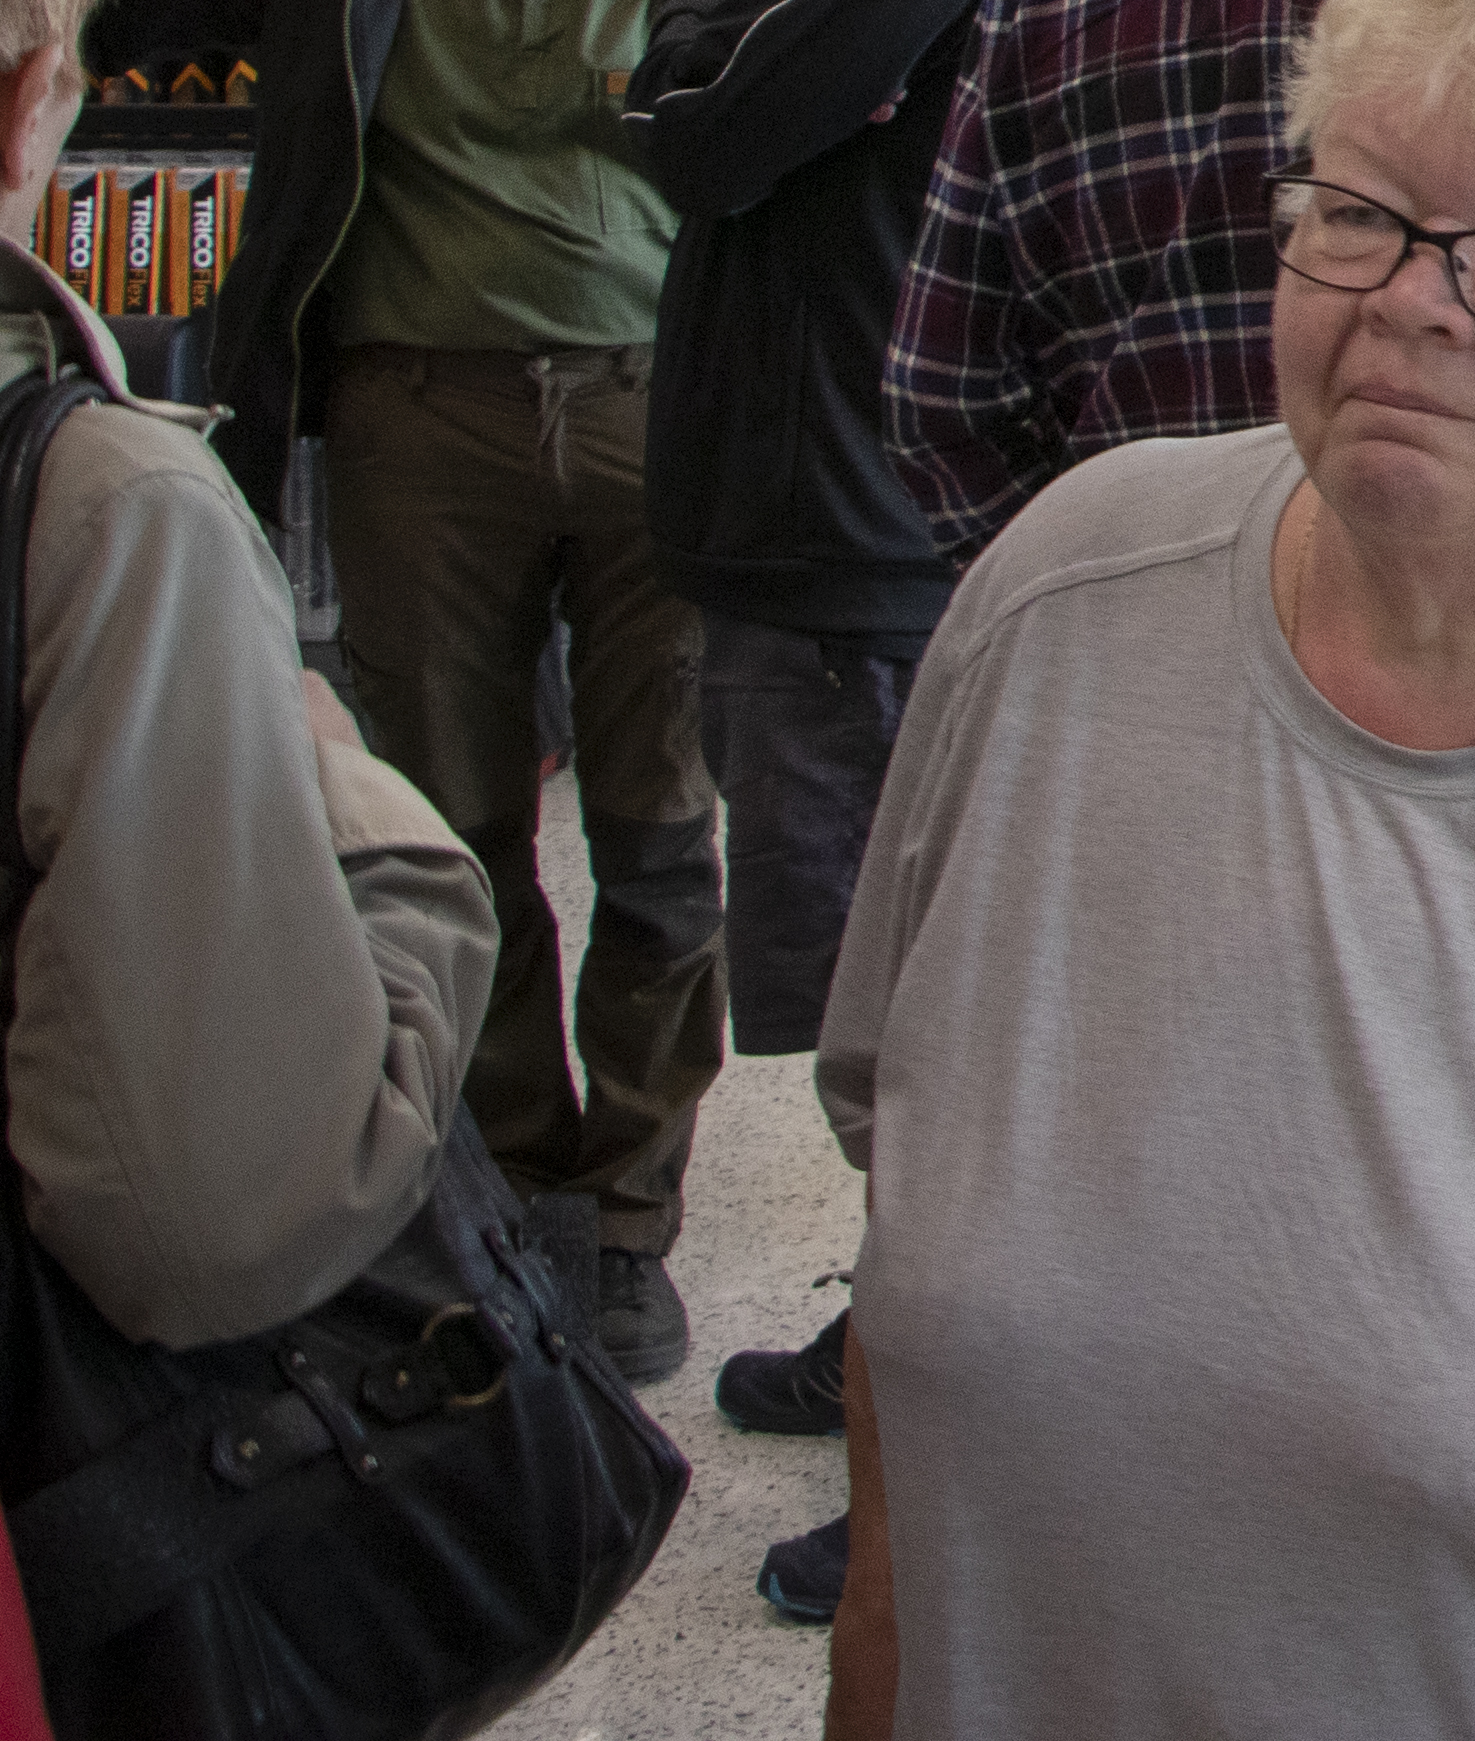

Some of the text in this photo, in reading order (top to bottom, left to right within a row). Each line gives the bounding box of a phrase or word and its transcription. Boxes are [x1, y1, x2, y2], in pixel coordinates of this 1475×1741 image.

[69, 196, 93, 269] TRICO
[127, 196, 152, 307] TRICO Flex
[192, 196, 214, 307] TRICO Flex
